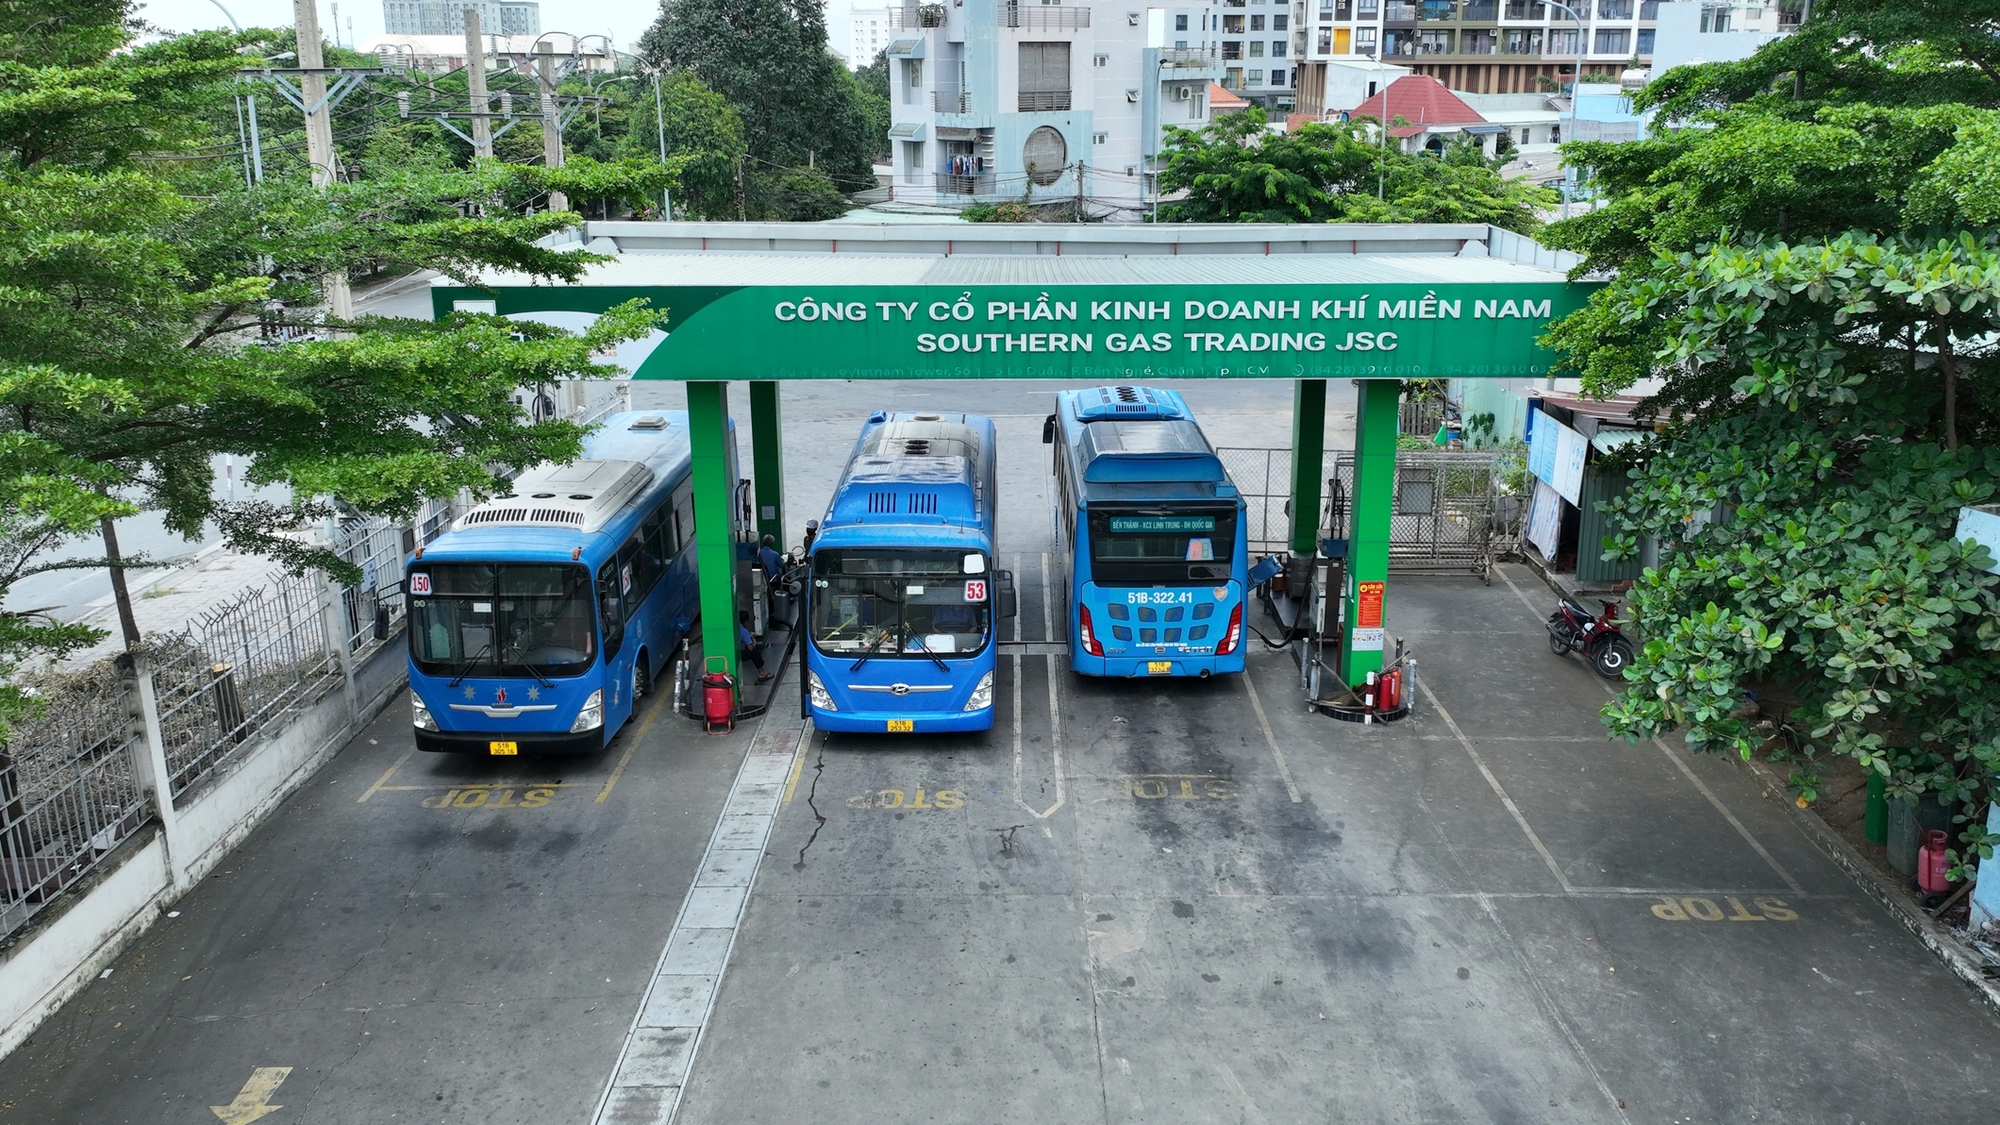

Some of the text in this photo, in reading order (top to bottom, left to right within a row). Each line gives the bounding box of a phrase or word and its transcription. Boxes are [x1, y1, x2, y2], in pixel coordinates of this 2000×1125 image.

[774, 290, 1552, 321] CÔNG TY CỔ PHẦN KINH DOANH KHÍ MIỀN NAM
[916, 332, 1398, 353] SOUTHERN GAS TRADING JSC
[412, 576, 429, 592] 150
[967, 583, 984, 599] 53
[1128, 592, 1193, 604] 51B-322.41
[421, 788, 556, 809] STOP
[845, 788, 967, 809] STOP
[1650, 896, 1799, 921] STOP
